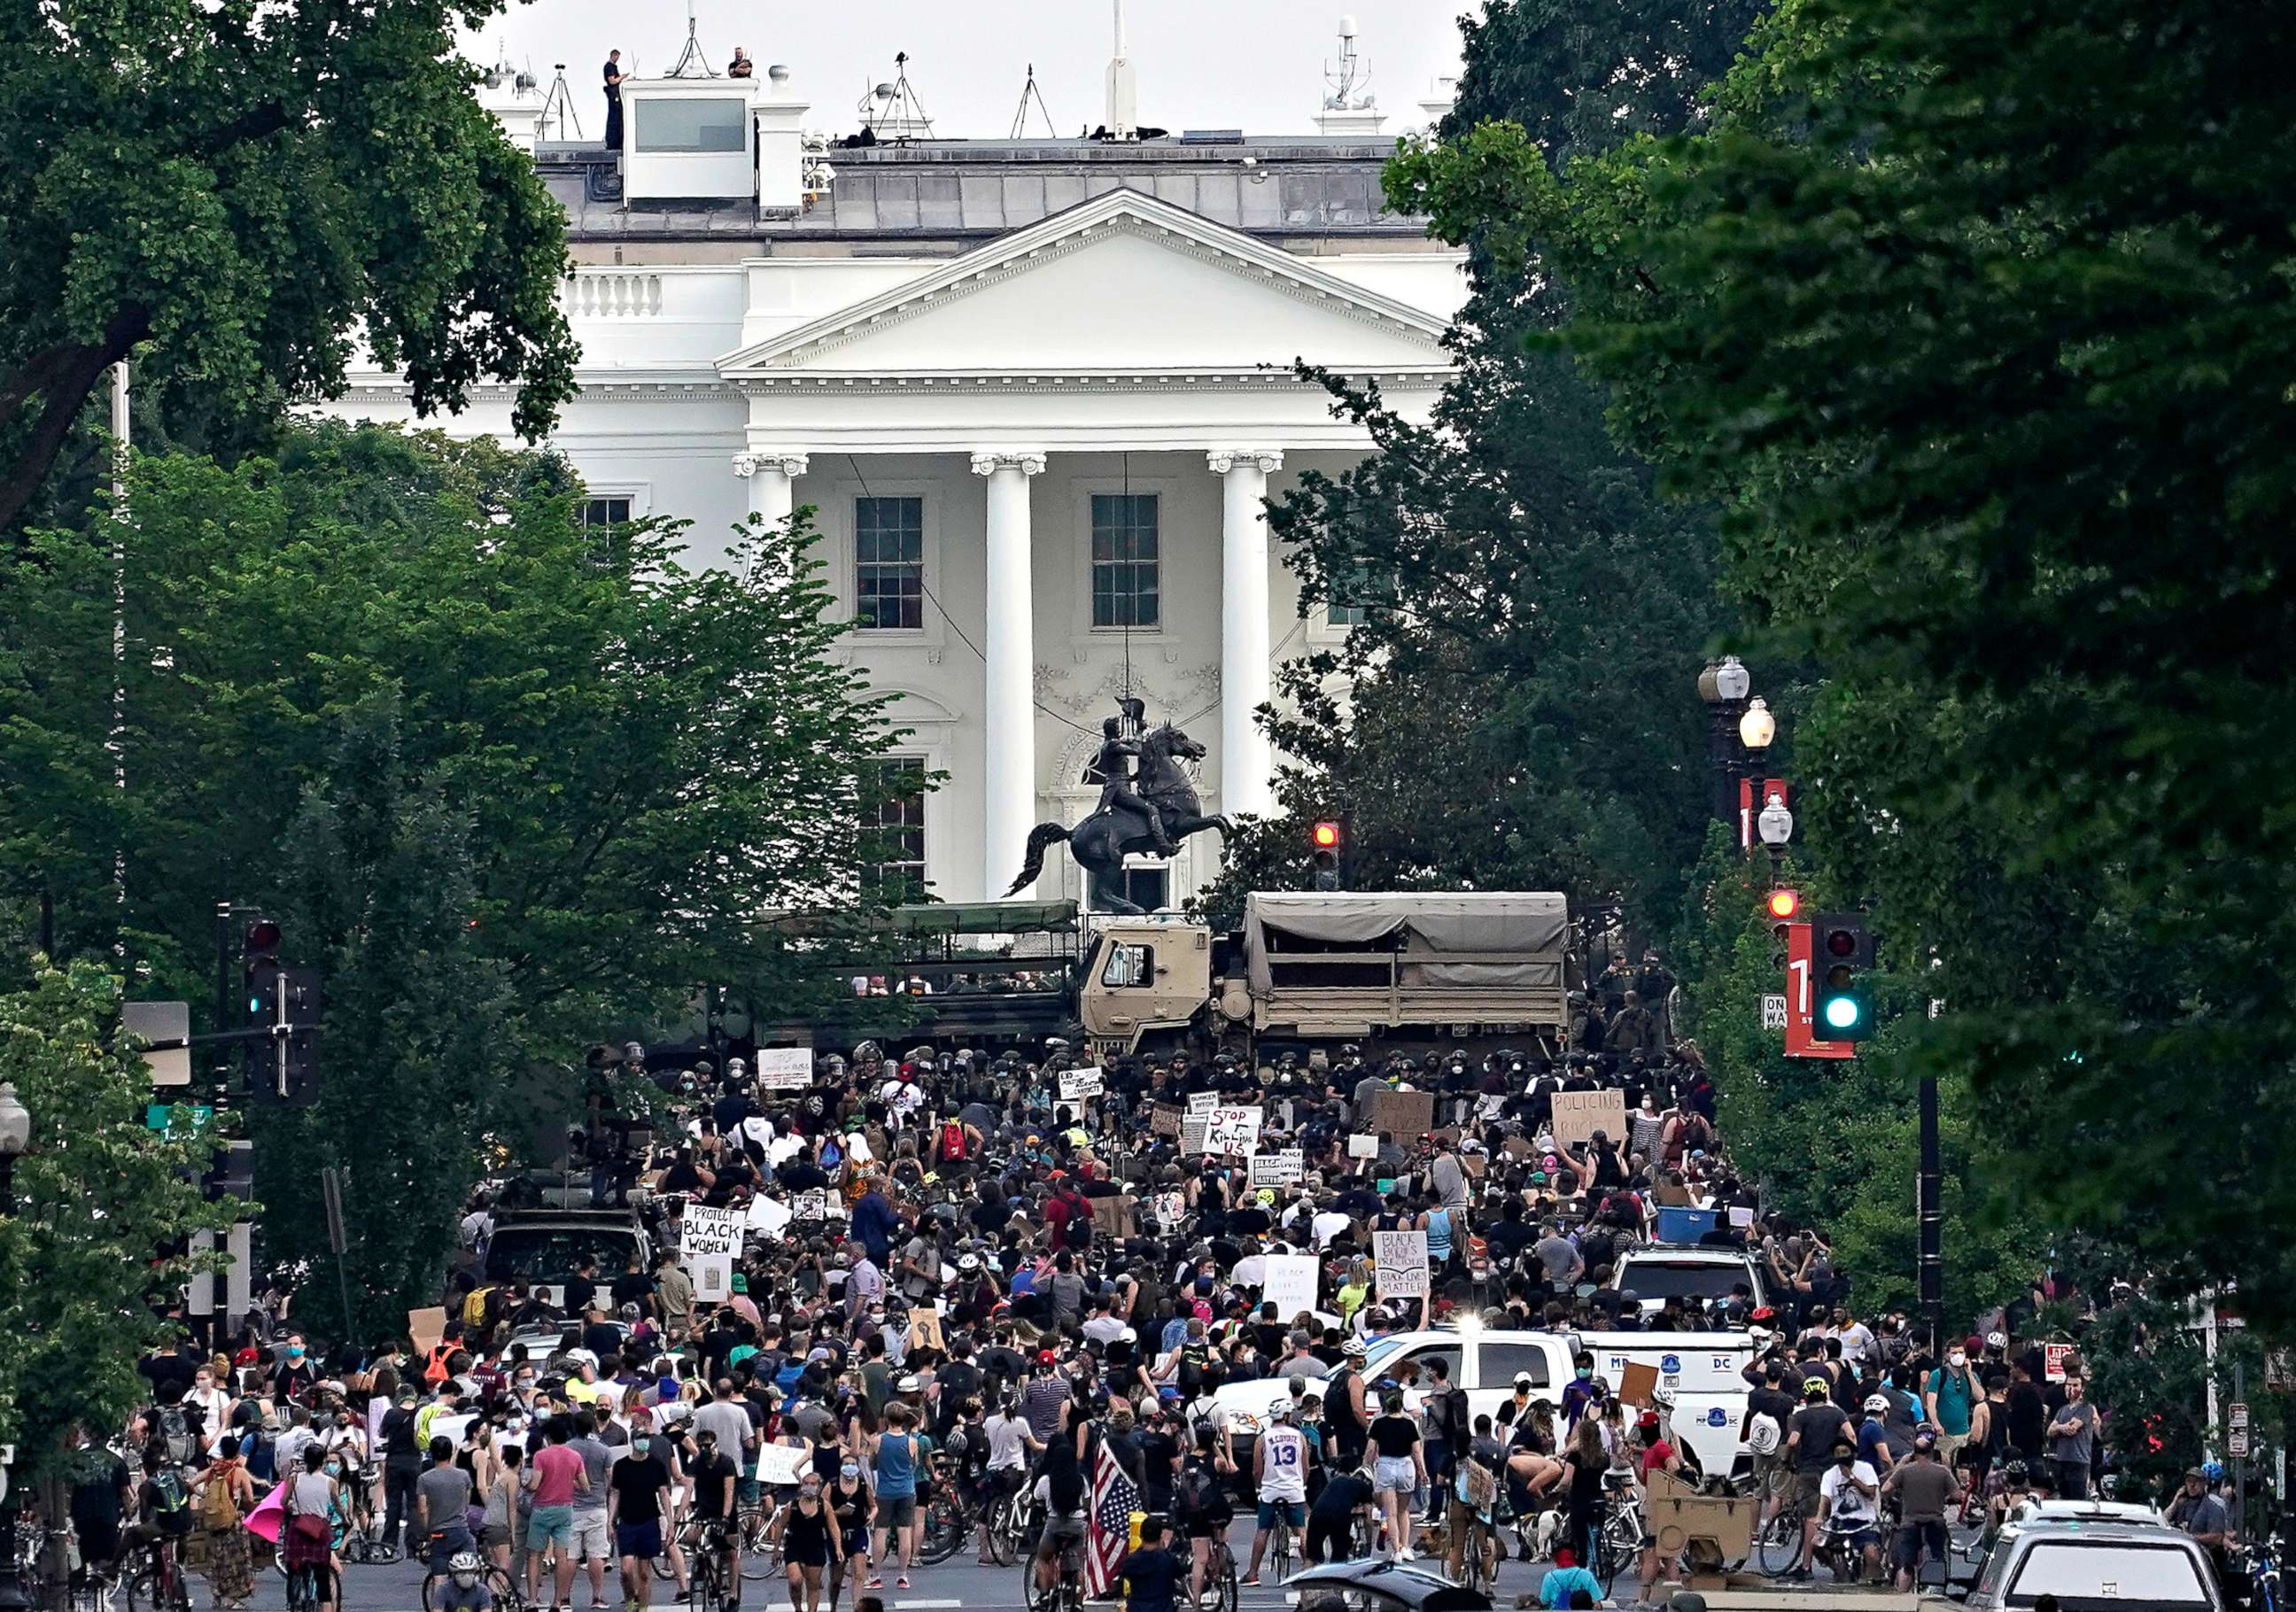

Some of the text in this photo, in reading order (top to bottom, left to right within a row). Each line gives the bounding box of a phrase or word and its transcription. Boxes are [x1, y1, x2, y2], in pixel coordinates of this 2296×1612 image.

[1767, 999, 1784, 1010] ON
[1766, 1011, 1786, 1023] WA
[1555, 1094, 1621, 1111] POLICING
[1210, 1110, 1246, 1126] STOP
[1561, 1120, 1613, 1139] RACIT
[1224, 1142, 1245, 1156] US
[694, 1206, 734, 1222] PROTECT
[684, 1220, 740, 1239] BLACK
[688, 1237, 730, 1253] WOMEN
[1381, 1233, 1416, 1247] BLACK
[1713, 1358, 1731, 1368] DC
[1273, 1445, 1297, 1466] 13
